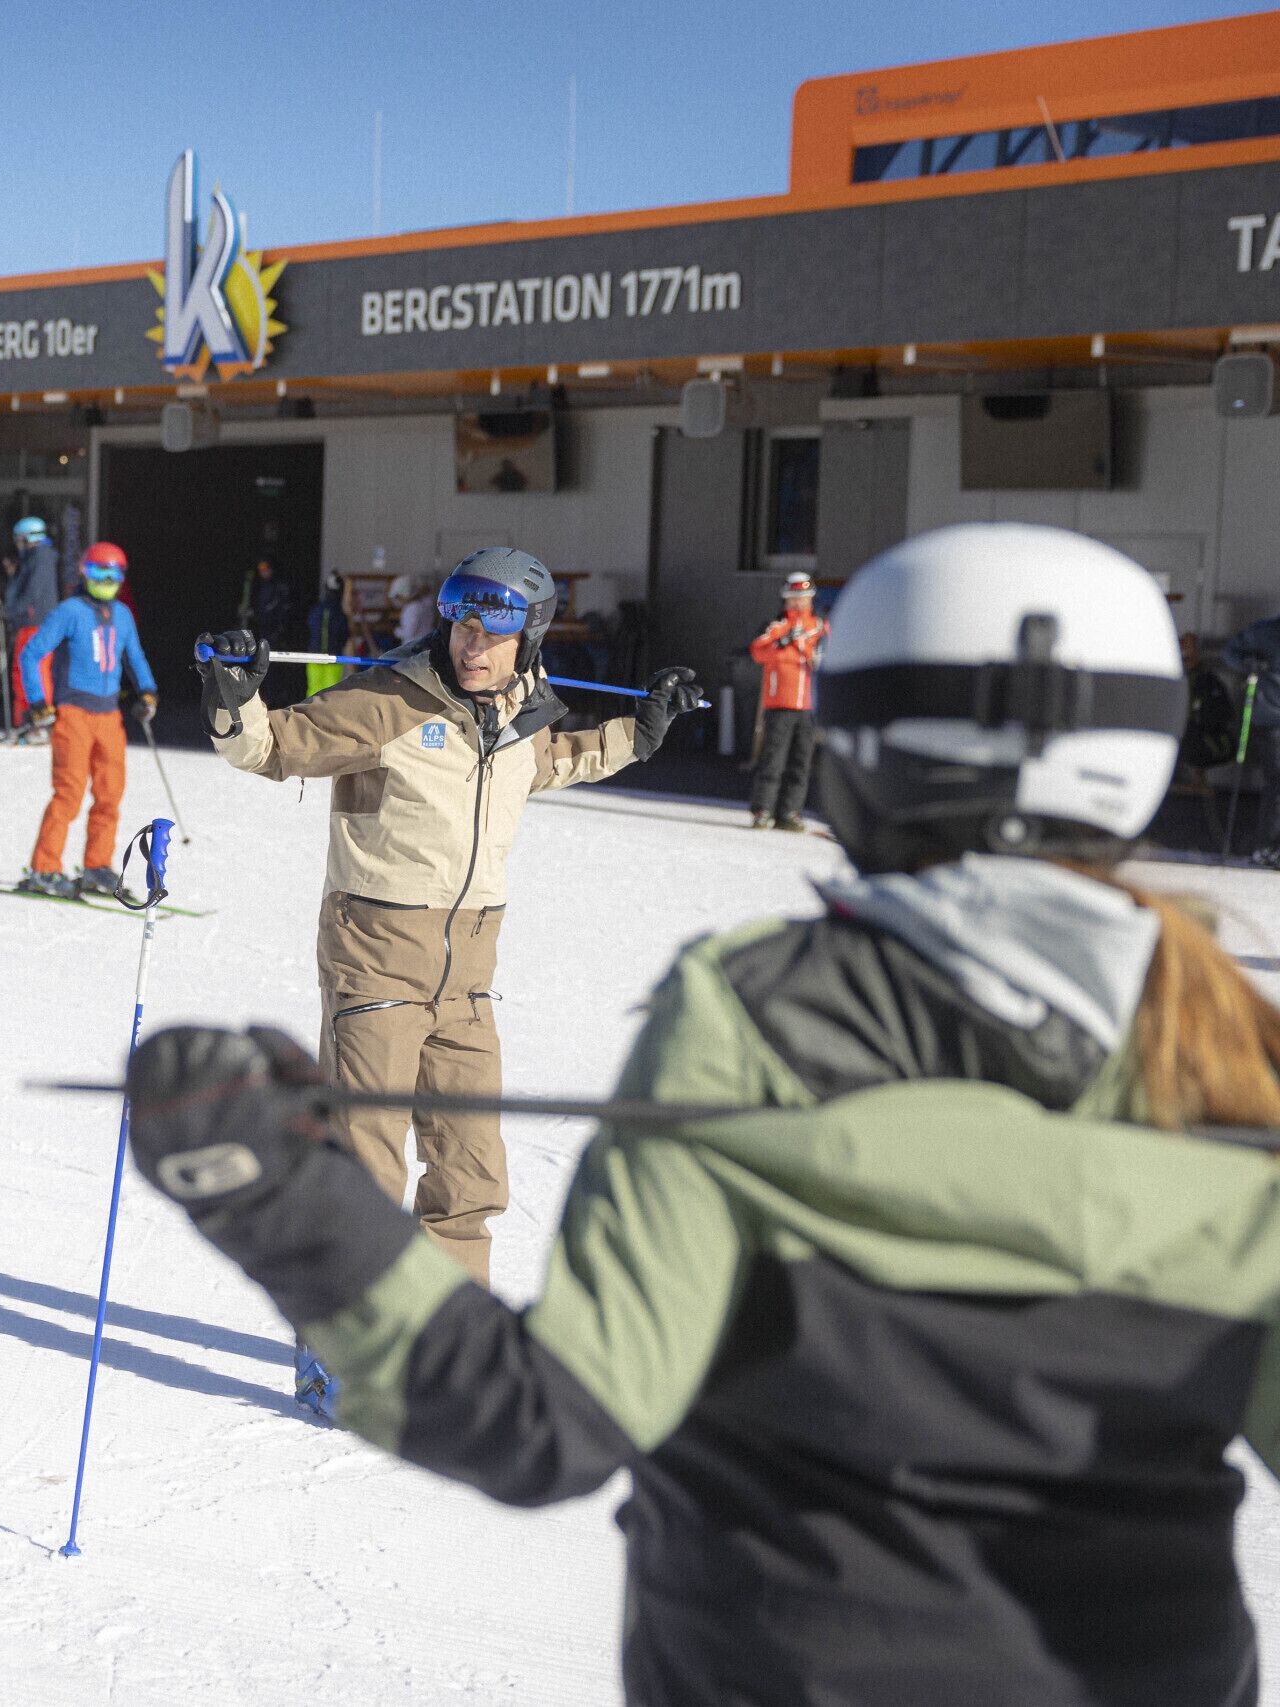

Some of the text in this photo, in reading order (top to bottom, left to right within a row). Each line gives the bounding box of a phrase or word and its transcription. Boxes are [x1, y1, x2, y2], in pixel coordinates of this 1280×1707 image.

[361, 265, 741, 336] BERGSTATION 1771m
[43, 318, 99, 358] 10er
